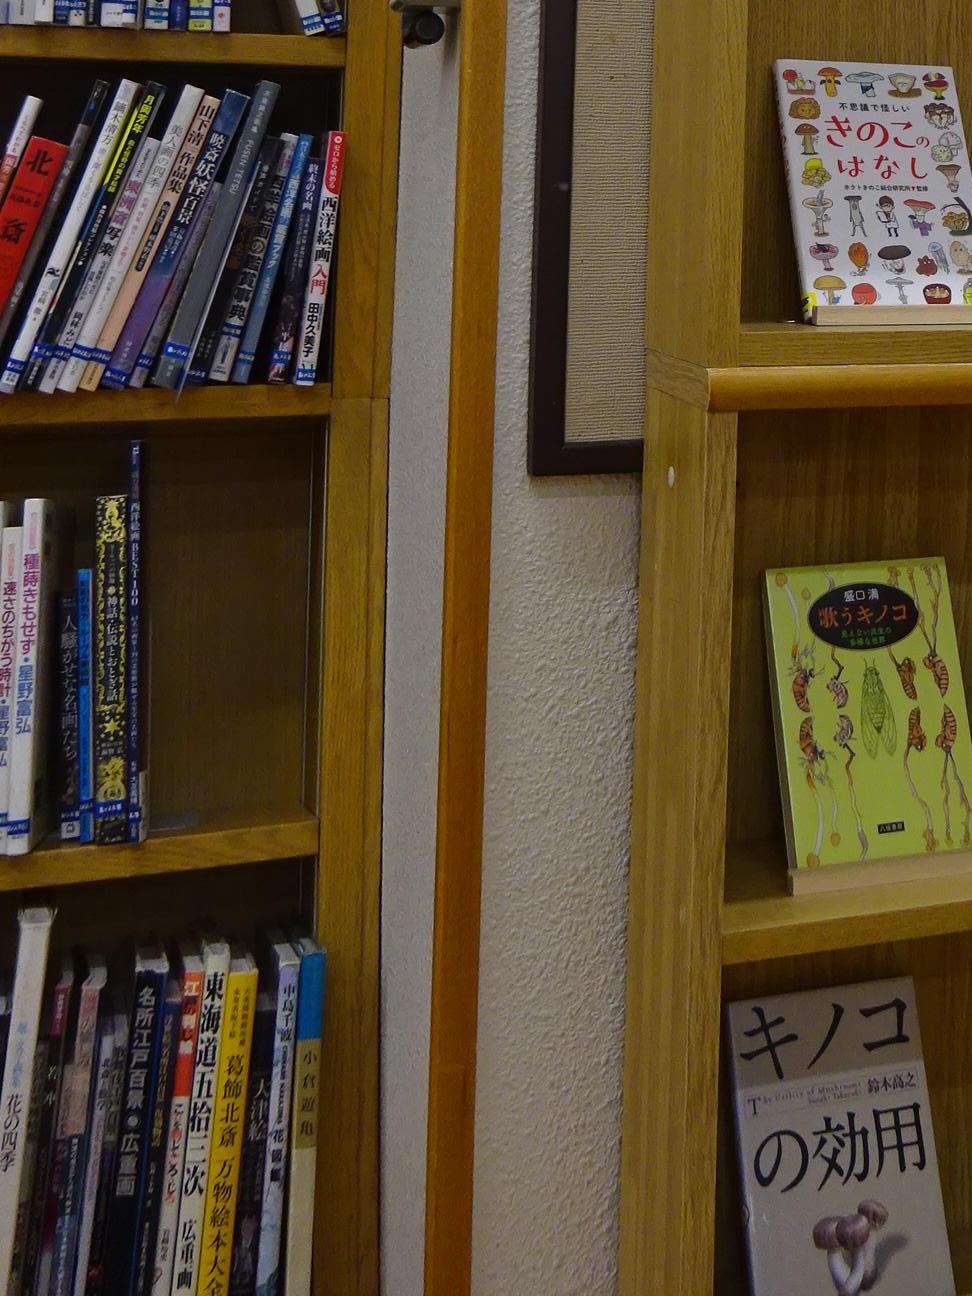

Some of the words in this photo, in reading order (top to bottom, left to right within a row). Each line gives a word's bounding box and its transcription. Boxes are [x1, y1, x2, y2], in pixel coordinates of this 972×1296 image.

[189, 104, 217, 146] 山下清
[824, 115, 931, 149] きのこの
[838, 102, 911, 113] 不思議で怪しい
[169, 151, 196, 194] 作品集
[837, 154, 929, 179] はなし
[309, 195, 339, 295] 西洋絵画入門
[0, 580, 18, 698] 速さのちがう時計
[20, 553, 41, 655] 種蒔きもせず
[818, 603, 908, 630] 歌うキノコ
[105, 596, 119, 702] 神話・伝説とおとぎ話
[15, 664, 34, 735] 星野富弘
[739, 997, 911, 1080] キノコ
[184, 972, 225, 1196] 東海道五拾三次
[218, 1054, 244, 1149] 葛飾北斎
[753, 1101, 927, 1193] の効用
[175, 1218, 197, 1290] 広重画
